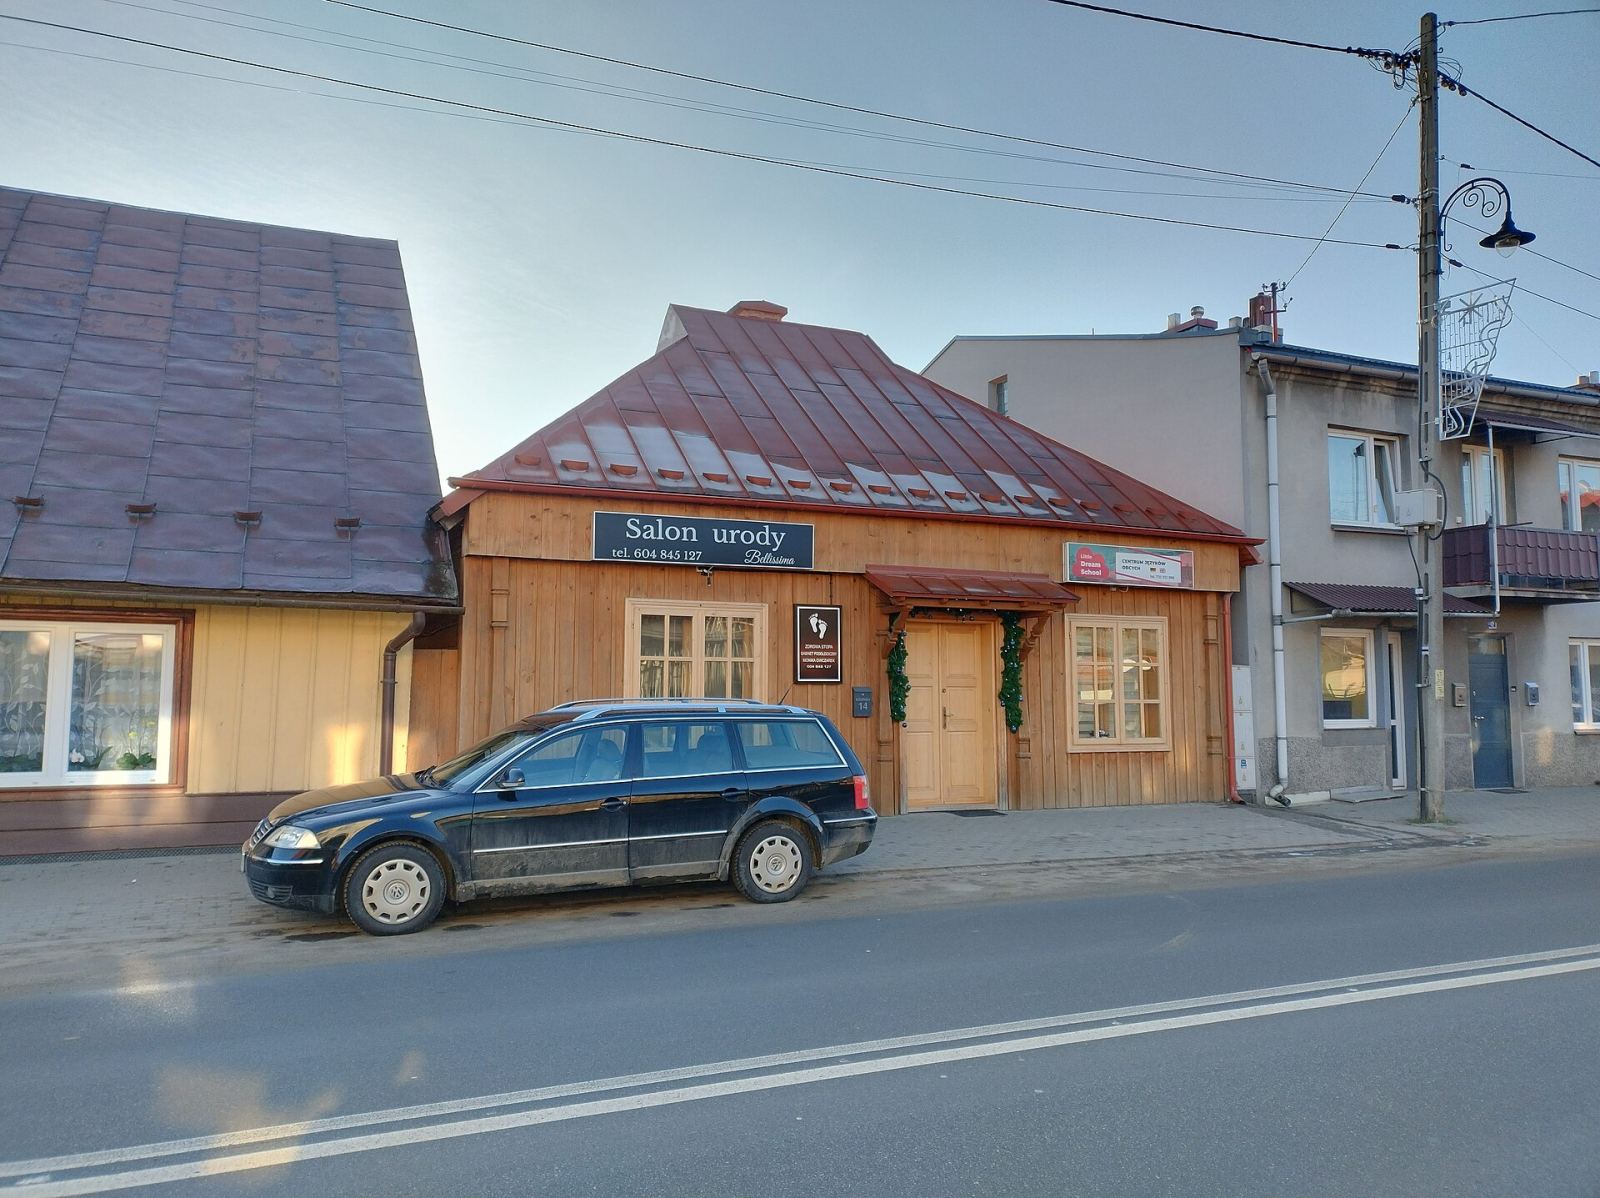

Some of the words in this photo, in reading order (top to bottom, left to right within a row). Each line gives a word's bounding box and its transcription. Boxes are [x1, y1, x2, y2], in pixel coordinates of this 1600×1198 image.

[625, 517, 698, 542] Salon
[711, 525, 786, 551] urody
[612, 548, 630, 558] tel.
[634, 548, 659, 560] 604
[660, 549, 681, 560] 845
[683, 550, 702, 561] 127
[744, 549, 796, 565] Bellissima
[858, 702, 868, 711] 14
